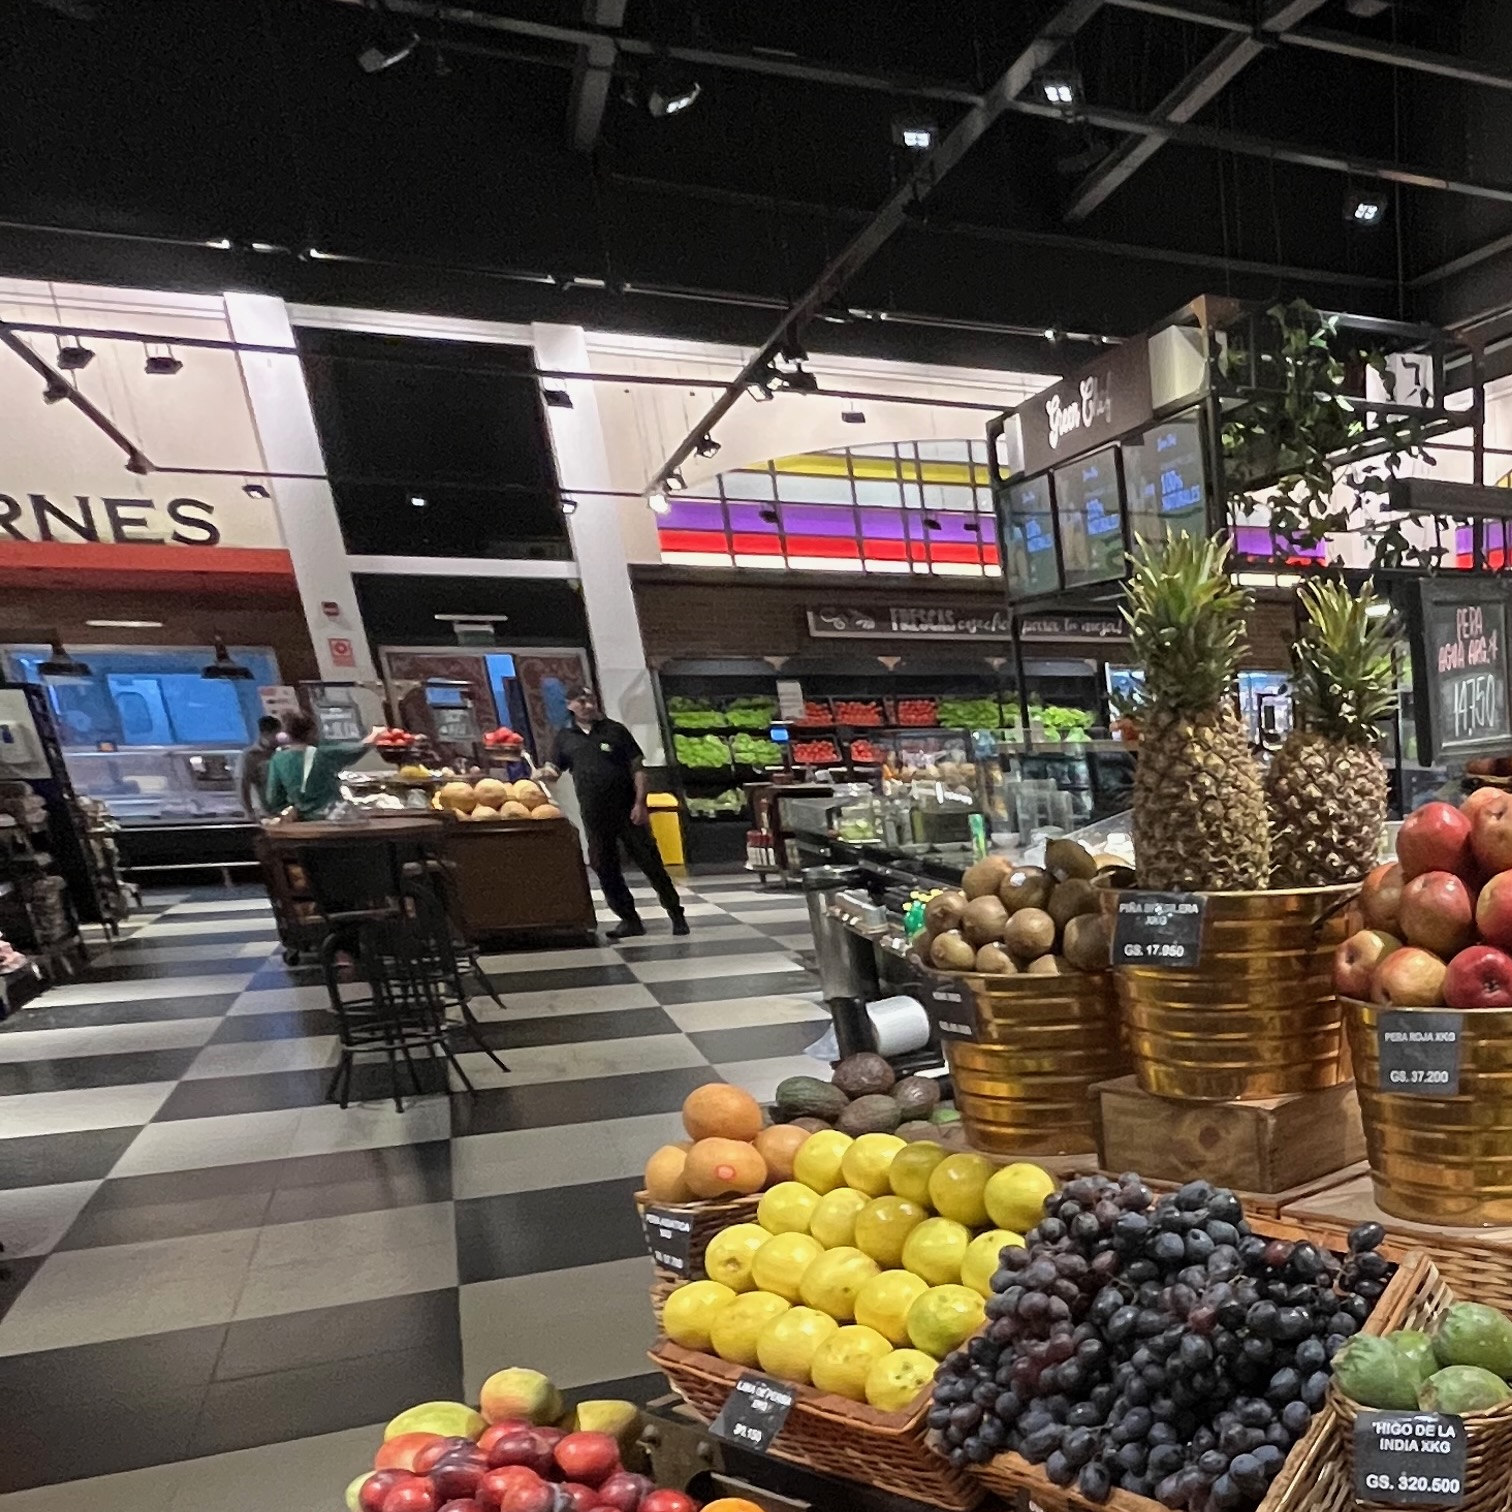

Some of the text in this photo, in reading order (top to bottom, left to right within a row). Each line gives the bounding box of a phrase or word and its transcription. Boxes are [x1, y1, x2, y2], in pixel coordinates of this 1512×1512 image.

[1457, 606, 1482, 640] PERA
[1124, 944, 1143, 957] GS.
[1390, 1070, 1449, 1083] GS. 37.200
[1415, 1425, 1436, 1436] DE
[1438, 1425, 1456, 1438] LA
[1379, 1438, 1451, 1454] INDIA XKG
[1366, 1474, 1460, 1494] GS. 320.500
